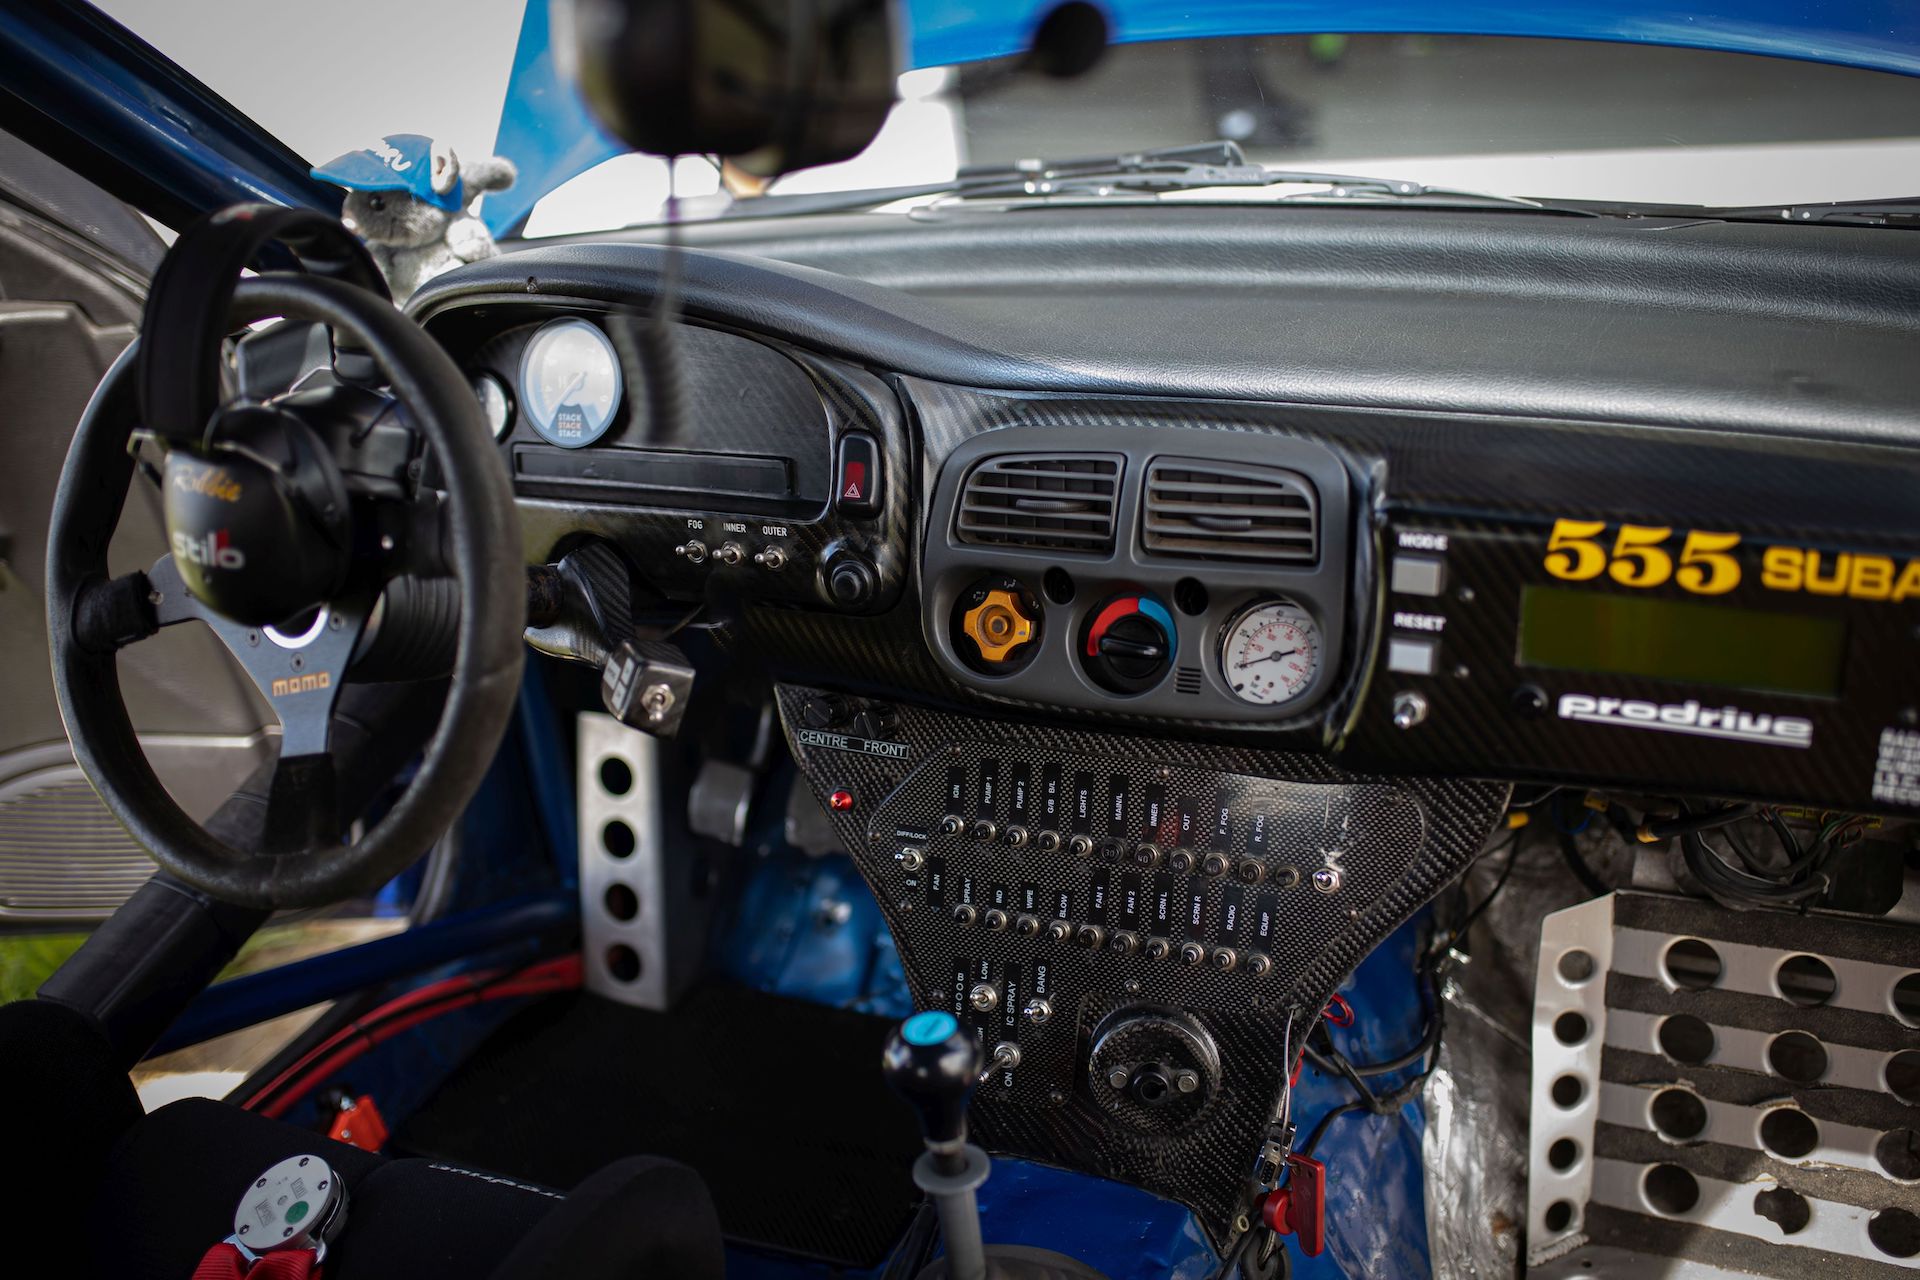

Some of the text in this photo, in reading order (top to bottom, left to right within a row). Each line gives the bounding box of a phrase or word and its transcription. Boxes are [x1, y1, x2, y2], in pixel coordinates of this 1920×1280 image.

[558, 413, 582, 422] STACK
[558, 422, 582, 430] STACK
[558, 430, 582, 438] STACK
[687, 519, 703, 530] FOG
[723, 522, 747, 534] INNER
[762, 525, 787, 537] OUTER
[1398, 532, 1449, 552] MODE
[1543, 518, 1742, 595] 555
[1393, 612, 1447, 633] RESET
[271, 671, 331, 697] momo
[1557, 692, 1814, 747] prodrive
[799, 730, 906, 758] CENTRE FRONT
[952, 784, 960, 799] IGN
[984, 781, 992, 804] PUMP
[1016, 788, 1024, 809] PUMP
[1047, 780, 1056, 814] G/B B/L
[1080, 789, 1088, 818] LIGHTS
[1150, 802, 1158, 827] INNER
[1182, 813, 1191, 831] OUT
[1220, 807, 1229, 826] FOG
[1256, 814, 1264, 833] FOG
[905, 879, 917, 887] ON
[932, 873, 940, 891] FAN
[963, 877, 971, 903] SPRAY
[995, 889, 1003, 904] IND
[1026, 889, 1034, 909] WIPE
[1059, 894, 1068, 918] BLOW
[1095, 893, 1103, 909] FAN
[1127, 898, 1135, 914] FAN
[1158, 899, 1167, 920] SCRN
[1192, 904, 1201, 925] SCRN
[1226, 904, 1236, 931] RADIO
[1260, 912, 1270, 937] EQUIP
[981, 960, 989, 980] LOW
[1036, 965, 1047, 994] BANG
[1006, 980, 1017, 1026] IC SPRAY
[1004, 1072, 1013, 1087] ON
